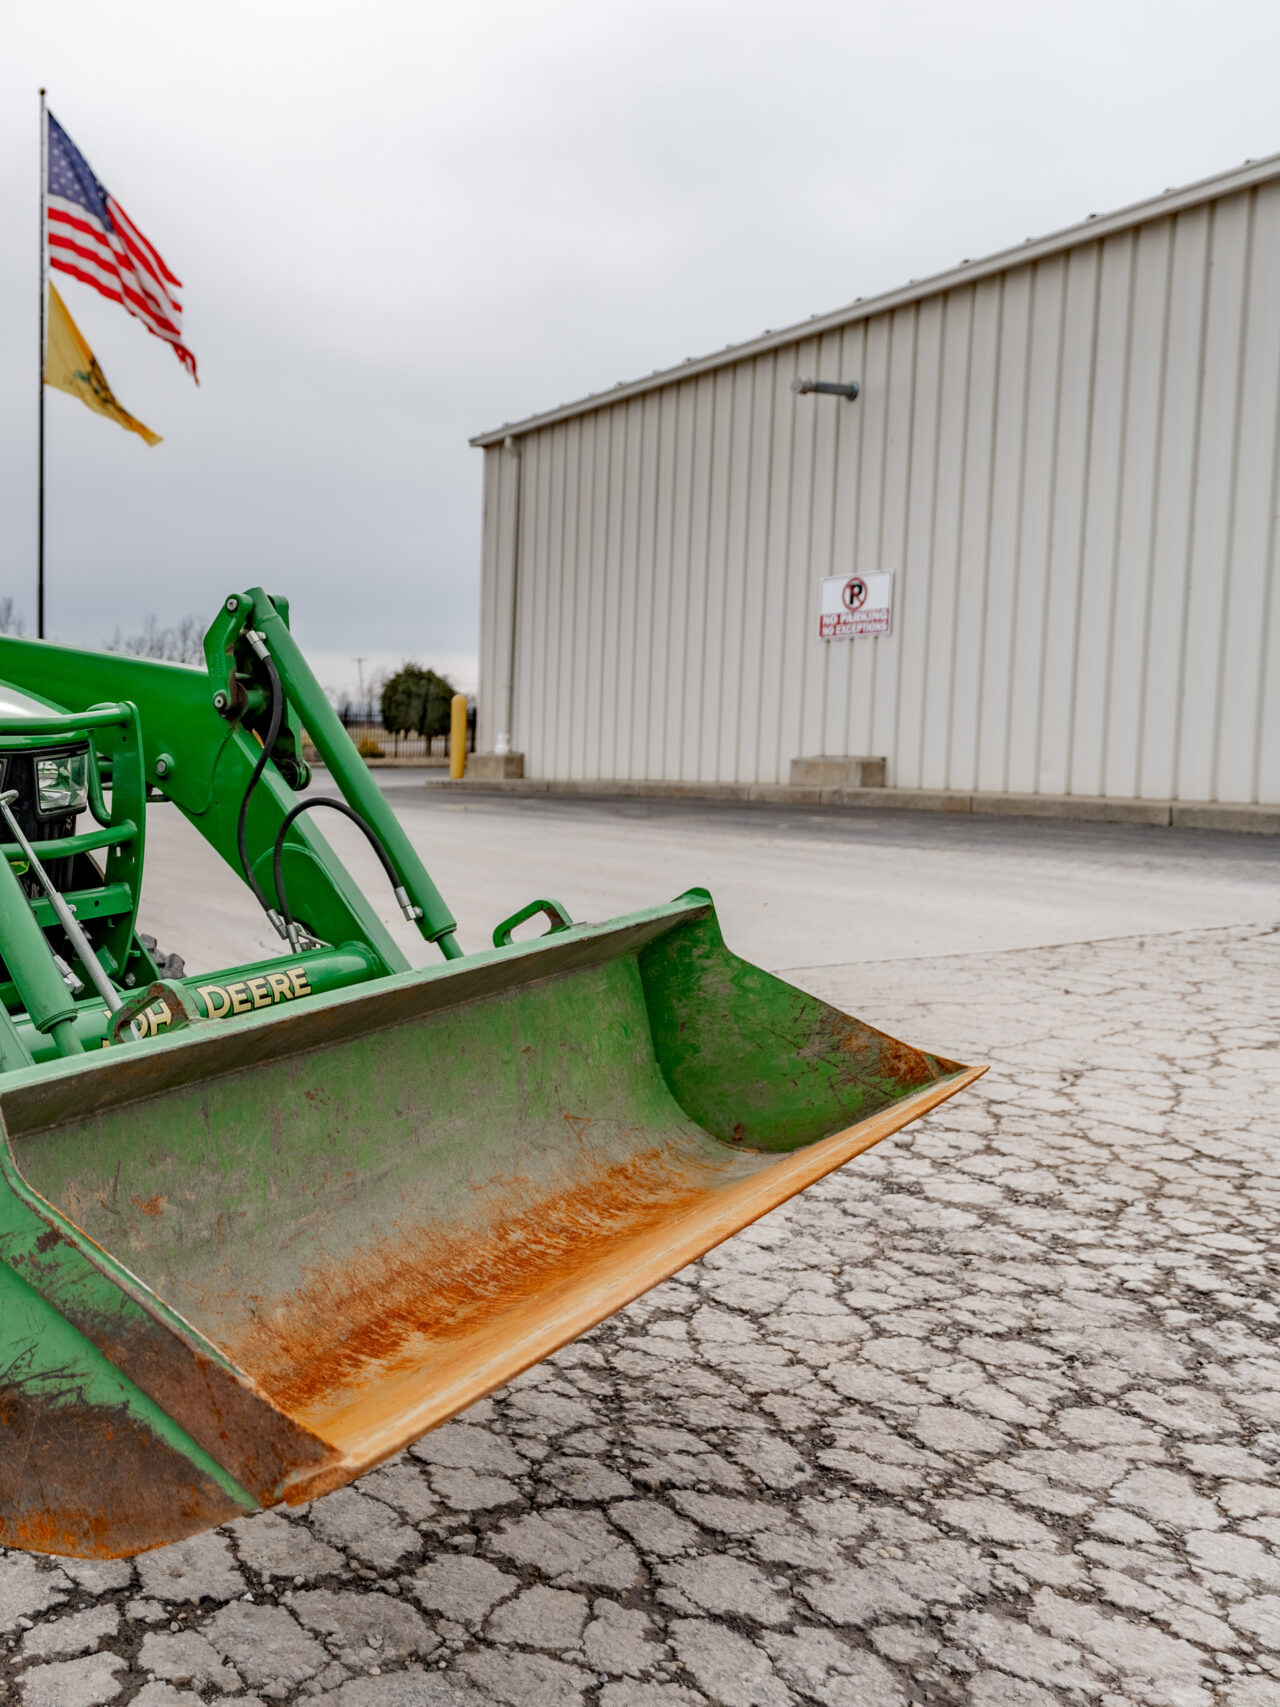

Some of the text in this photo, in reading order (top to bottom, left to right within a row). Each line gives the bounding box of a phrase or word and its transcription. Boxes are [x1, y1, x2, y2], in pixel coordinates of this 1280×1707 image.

[822, 609, 888, 625] NO PARKING
[822, 620, 888, 636] NO EXCEPTIONS
[196, 967, 312, 1019] DEERE
